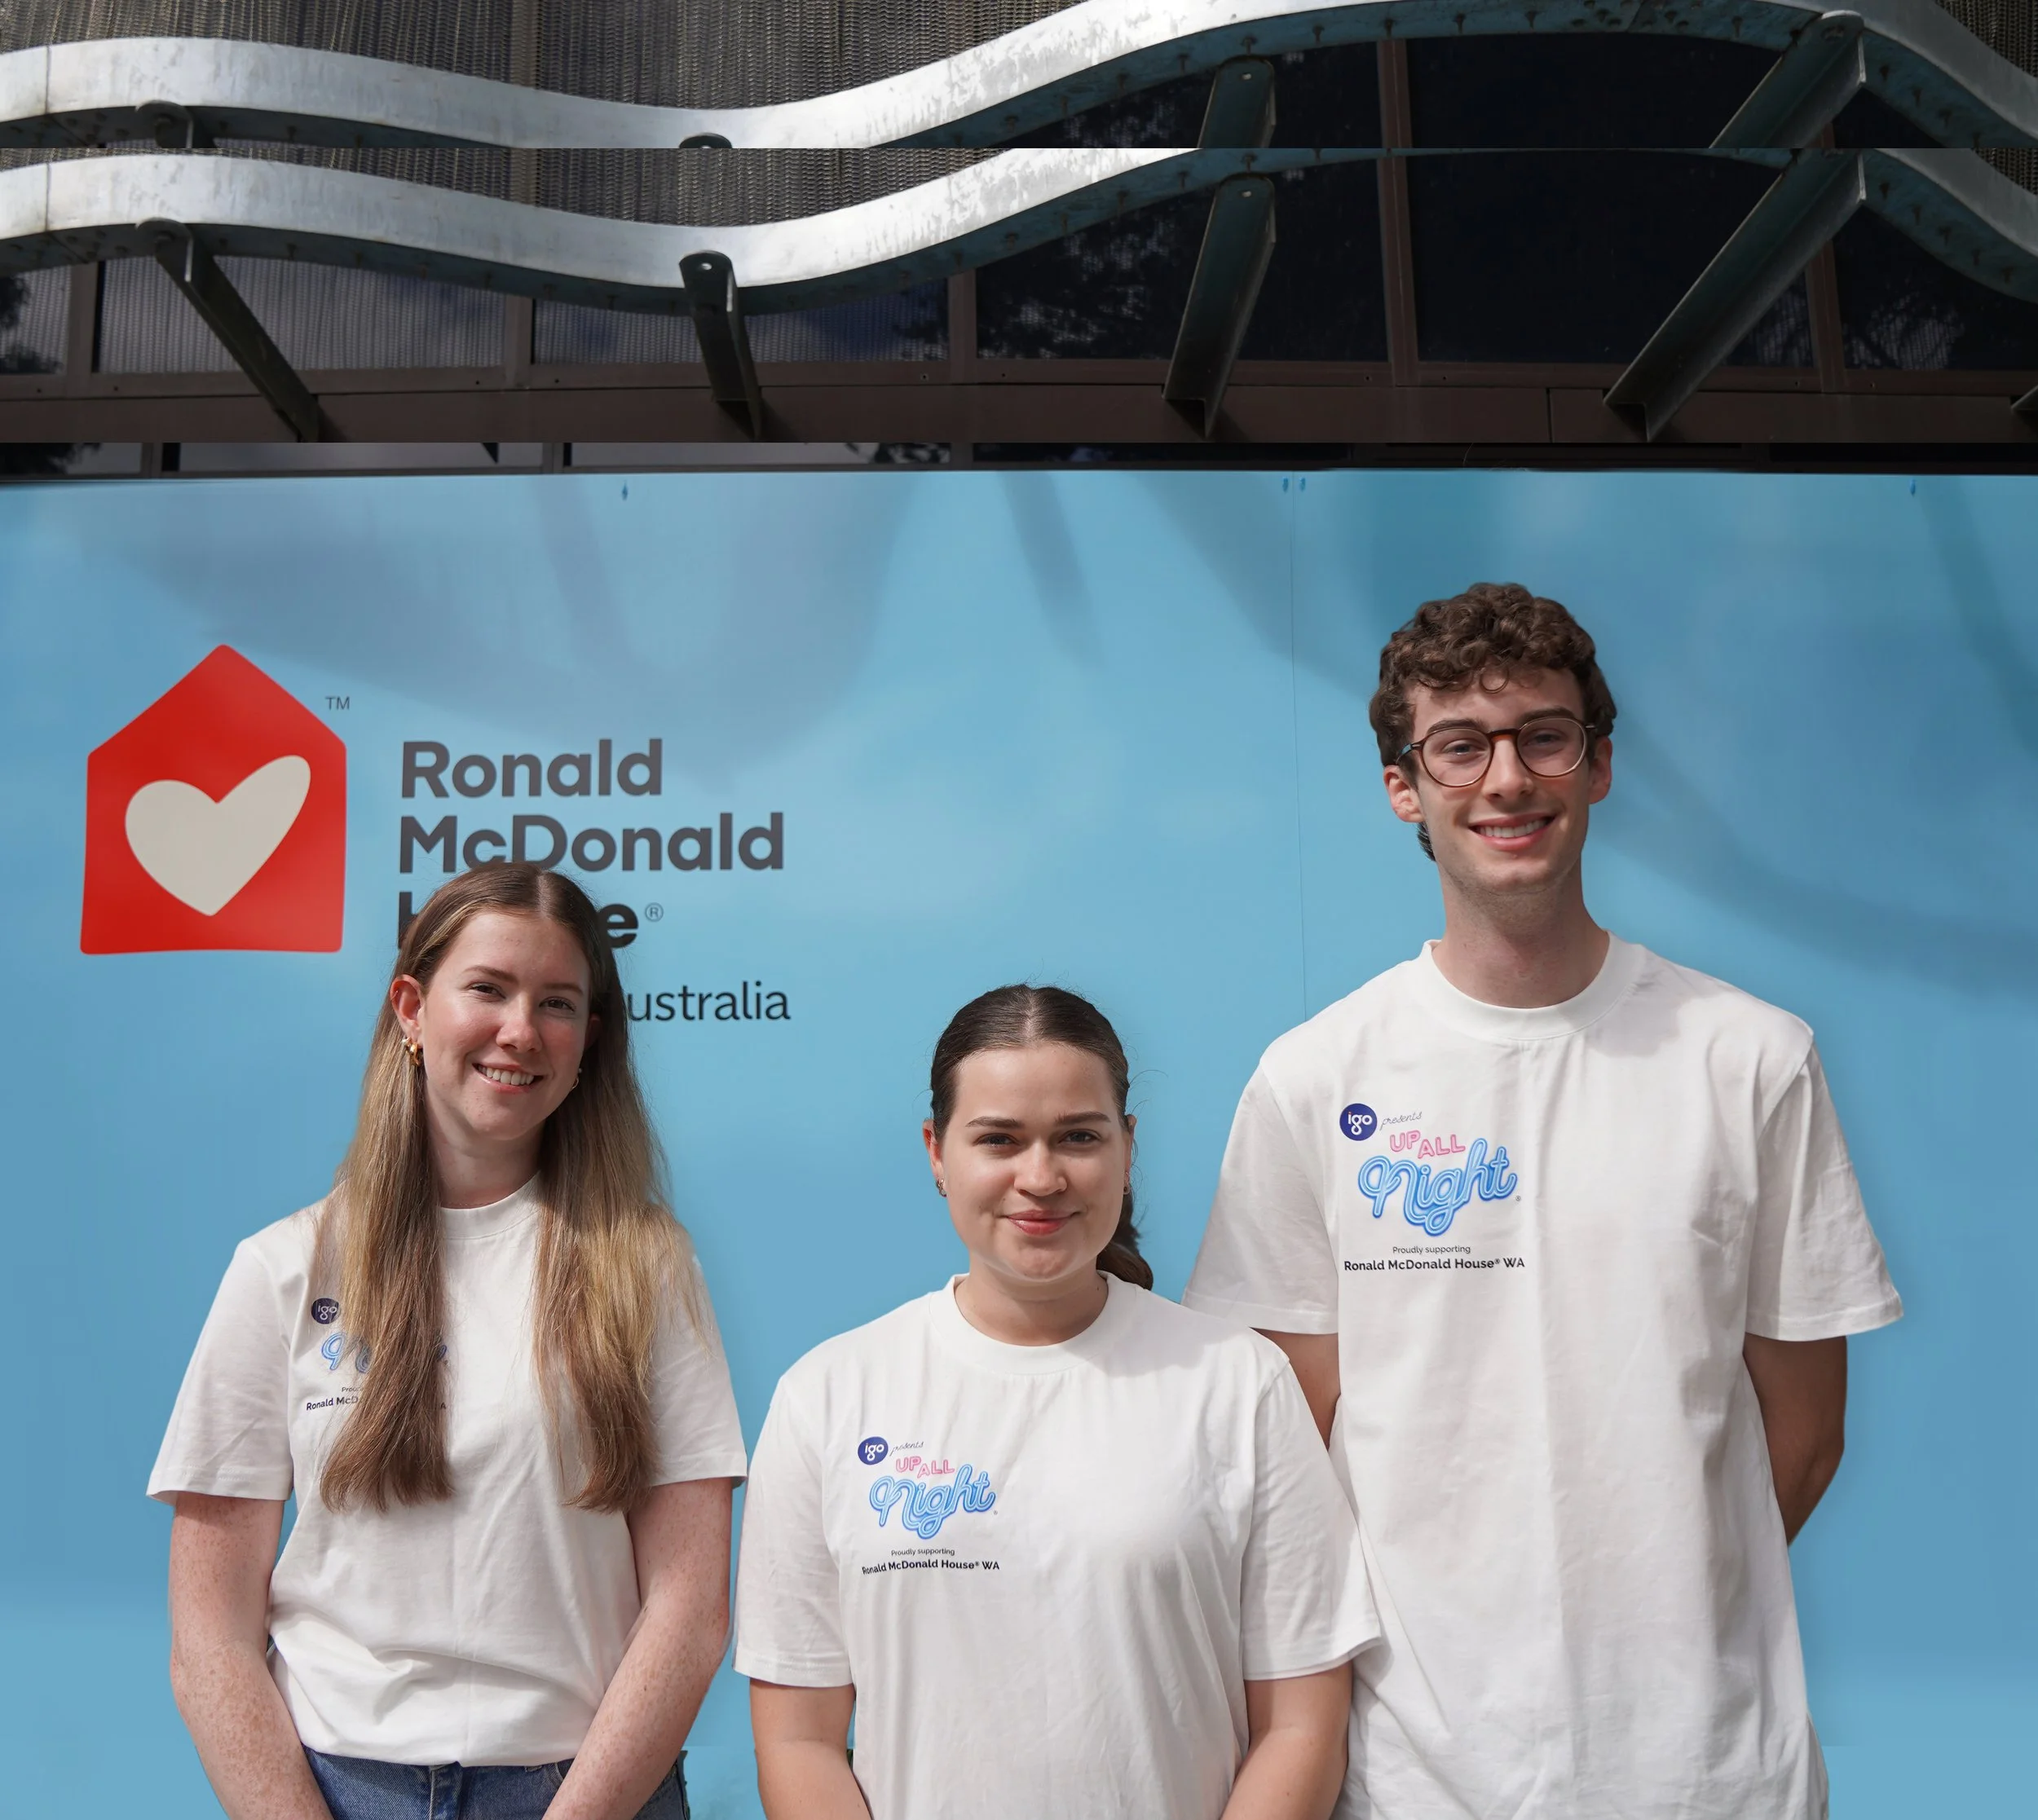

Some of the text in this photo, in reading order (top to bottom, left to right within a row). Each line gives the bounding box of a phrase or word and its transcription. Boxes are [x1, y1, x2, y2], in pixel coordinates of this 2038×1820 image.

[325, 696, 351, 710] TM
[401, 738, 663, 799] Ronald
[399, 812, 784, 874] McDonald
[627, 981, 792, 1021] ustralia
[1379, 1111, 1423, 1131] presents
[1390, 1130, 1466, 1159] UP ALL
[1357, 1138, 1518, 1237] Night
[1392, 1245, 1471, 1255] Proudly supporting
[1344, 1260, 1385, 1271] Ronald
[1387, 1258, 1451, 1271] McDonald
[1502, 1258, 1525, 1268] WA
[306, 1397, 334, 1411] Ronald
[889, 1440, 924, 1457] presents
[895, 1456, 955, 1478] UP ALL
[869, 1464, 996, 1540] Night
[891, 1548, 955, 1557] Proudly supporting
[862, 1563, 887, 1575] Ronald
[889, 1558, 938, 1571] McDonald
[982, 1561, 1000, 1571] WA
